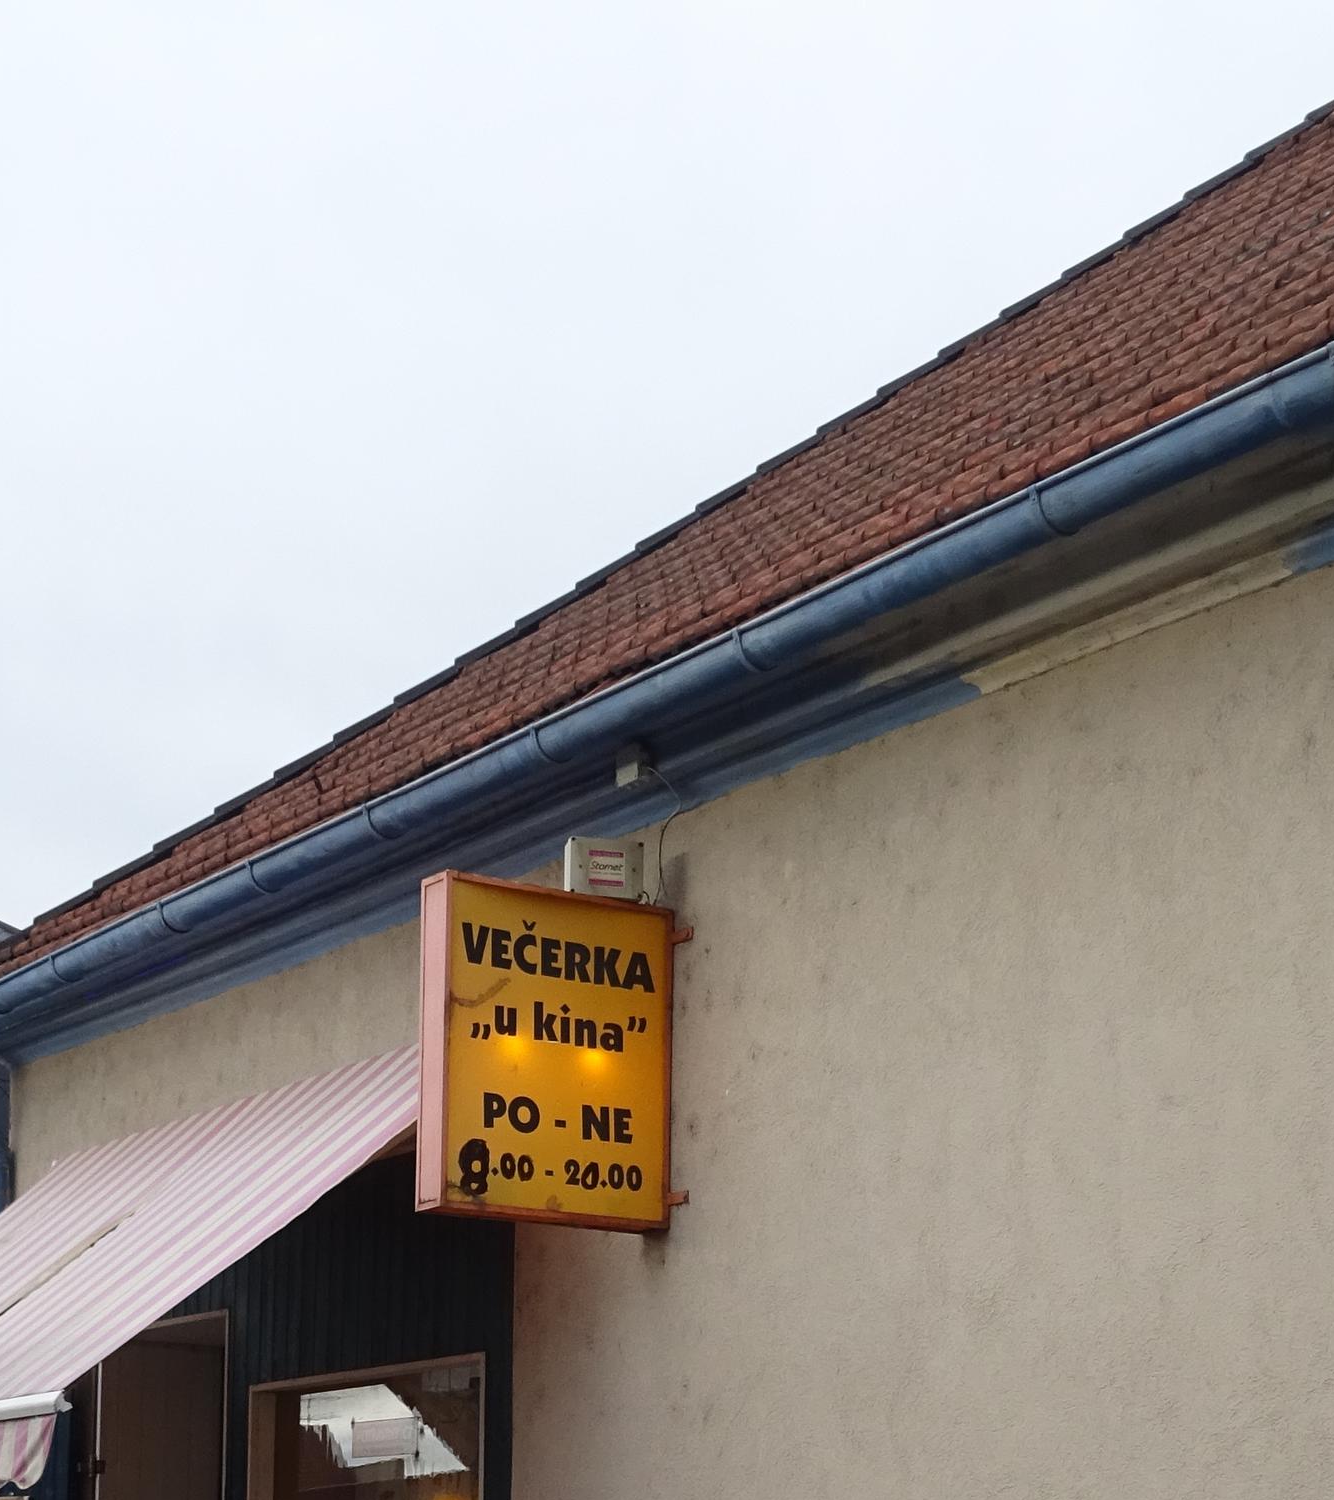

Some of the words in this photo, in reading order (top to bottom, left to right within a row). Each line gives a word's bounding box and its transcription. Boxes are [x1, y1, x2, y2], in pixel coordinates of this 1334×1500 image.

[462, 920, 655, 993] VEČERKA
[482, 1092, 540, 1134] PO
[581, 1104, 633, 1144] NE
[564, 1158, 643, 1191] 20.00
